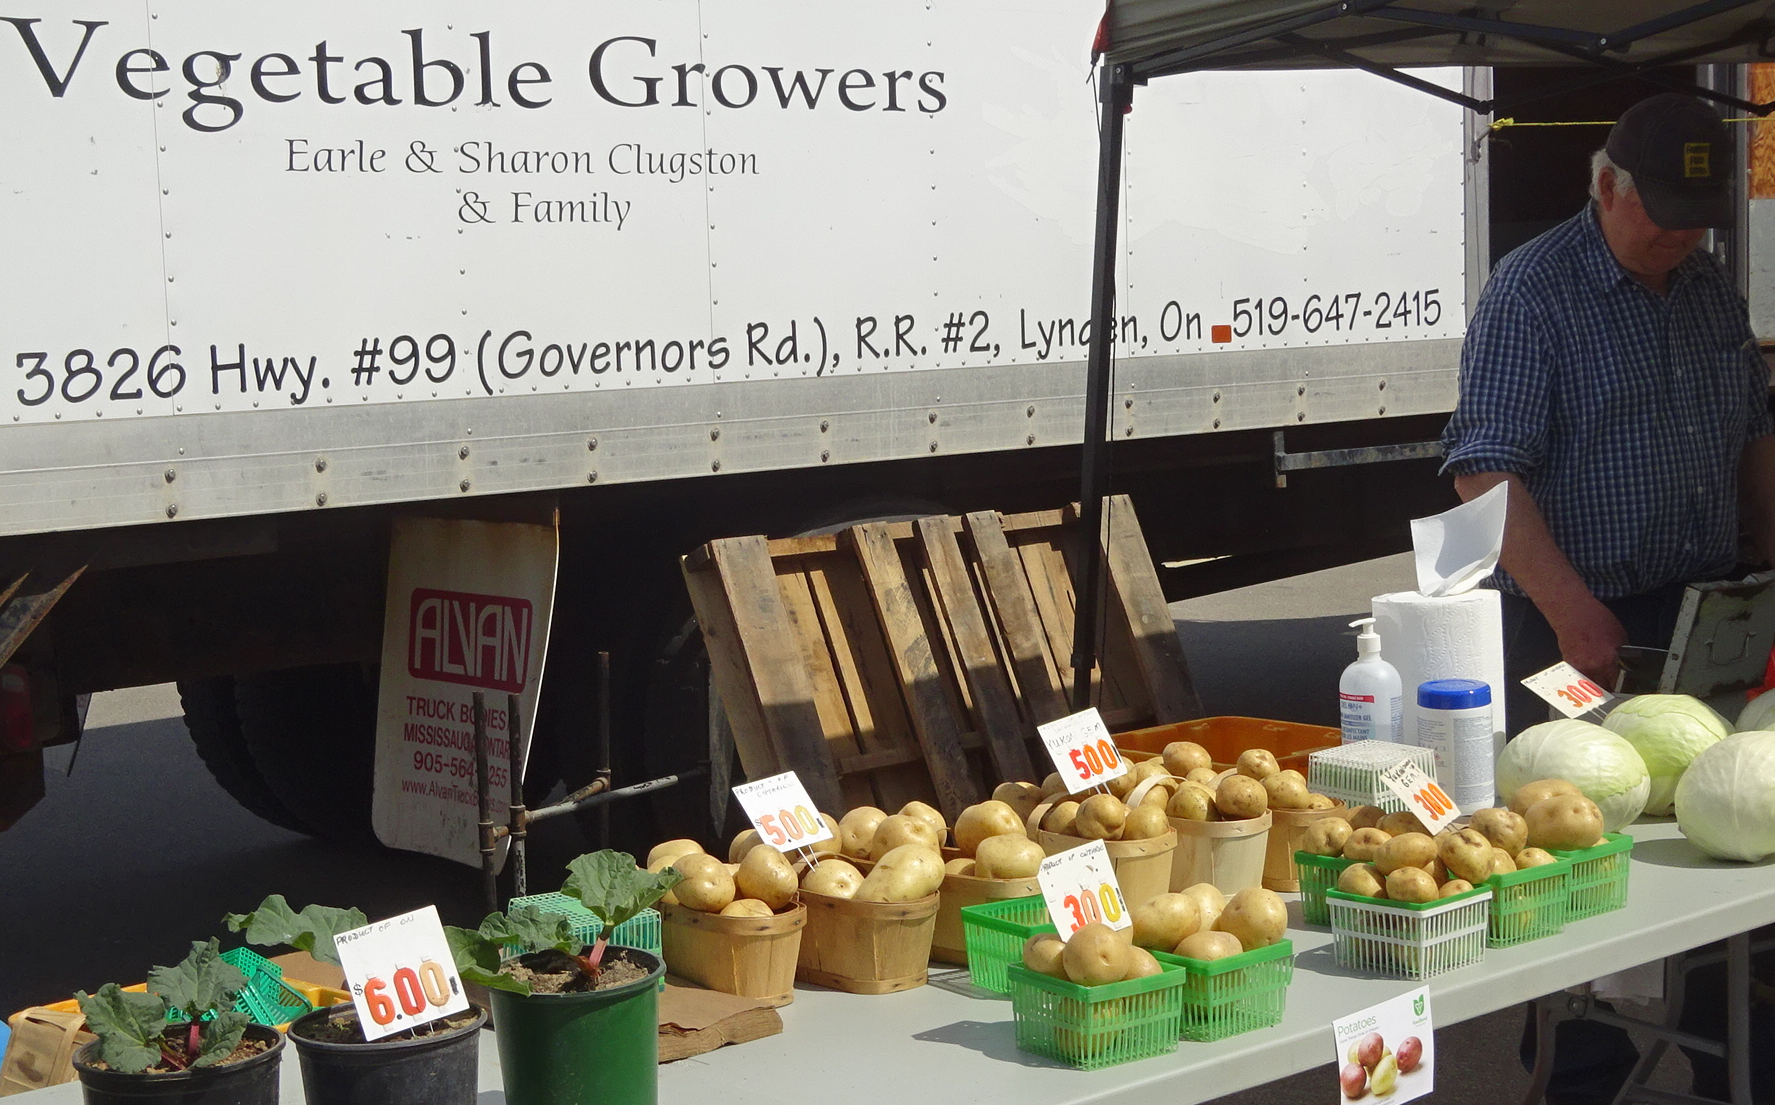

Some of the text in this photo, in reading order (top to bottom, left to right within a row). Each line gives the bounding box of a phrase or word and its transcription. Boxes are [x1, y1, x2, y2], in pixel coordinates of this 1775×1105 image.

[0, 17, 948, 133] Vegetable Growers
[285, 138, 760, 183] Earle & Sharon Clugston
[457, 190, 631, 231] & Family
[16, 345, 187, 407] 3826
[209, 342, 332, 405] Hwy.
[351, 334, 457, 388] #99
[477, 329, 731, 395] (Governors
[856, 314, 927, 360] R.R.
[943, 310, 1002, 357] #2,
[1160, 300, 1202, 342] On
[1232, 288, 1442, 338] 519-647-2415
[414, 598, 528, 684] ALVAN
[406, 695, 456, 722] TRUCK
[1556, 679, 1604, 708] 300
[413, 750, 508, 788] 905-564-255
[1413, 782, 1453, 821] 300
[336, 926, 375, 946] PRODUCT
[378, 921, 392, 932] OF
[1338, 1015, 1377, 1037] Potatoes
